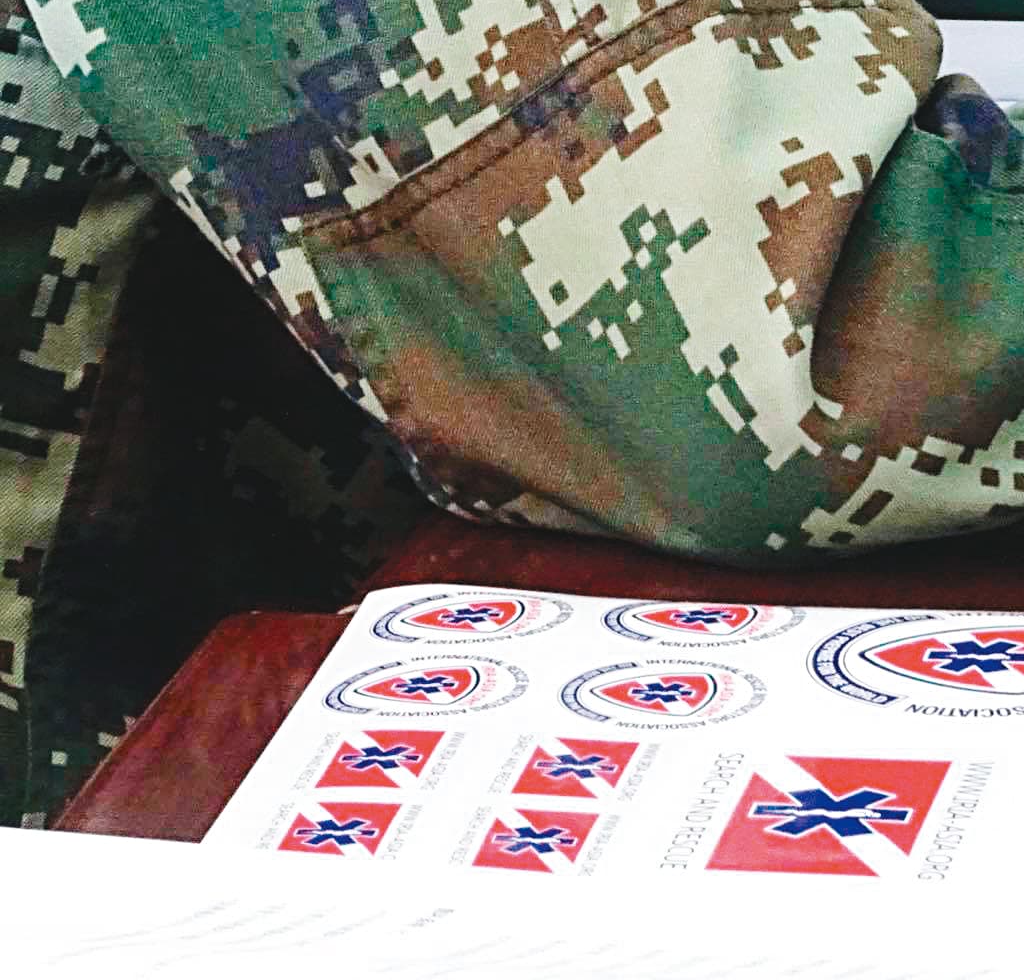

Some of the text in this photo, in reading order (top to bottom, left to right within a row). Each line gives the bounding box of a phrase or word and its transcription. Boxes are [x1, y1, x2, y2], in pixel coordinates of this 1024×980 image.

[699, 753, 745, 794] SEARCH
[684, 797, 721, 823] AND
[660, 826, 706, 869] RESCUE
